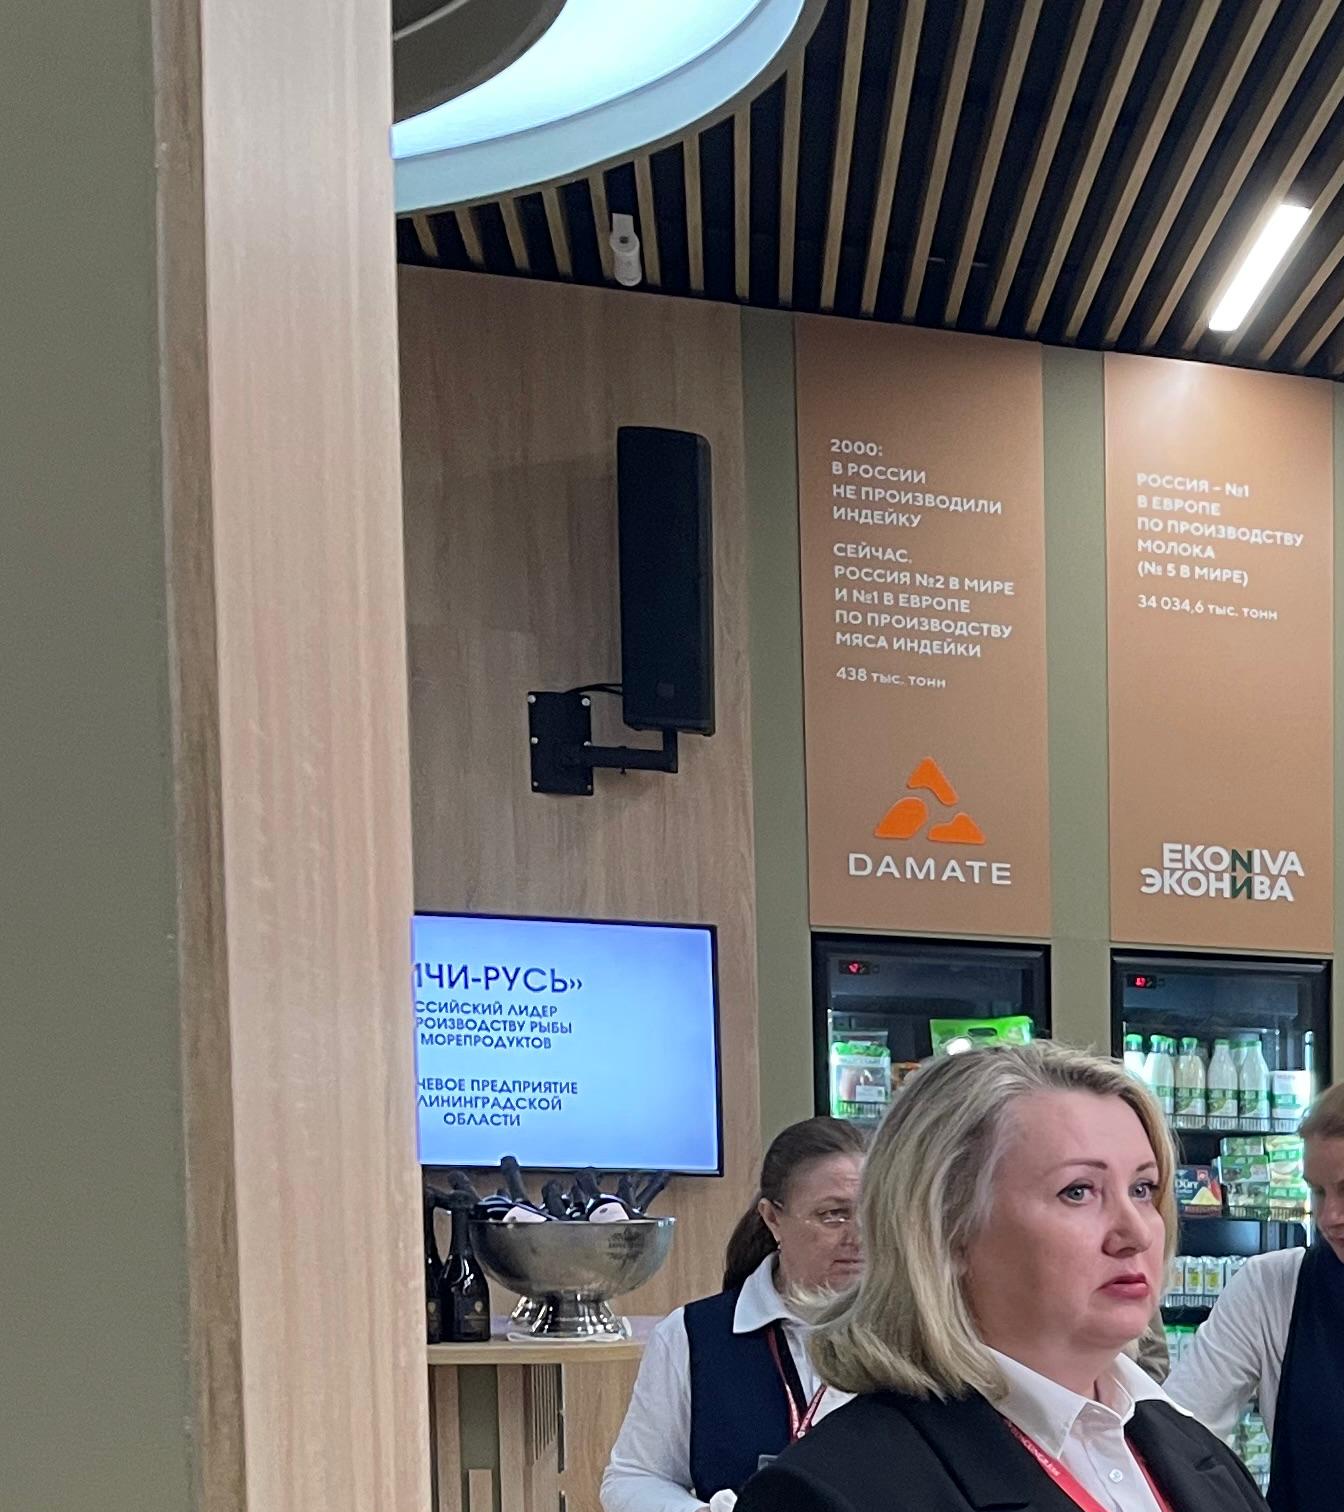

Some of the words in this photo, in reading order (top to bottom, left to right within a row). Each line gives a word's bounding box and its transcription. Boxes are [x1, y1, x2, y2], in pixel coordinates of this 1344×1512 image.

[830, 438, 883, 457] 2000:
[831, 461, 843, 475] В
[847, 463, 927, 484] РОССИИ
[1136, 472, 1209, 493] РОССИЯ
[1225, 482, 1249, 497] №1
[832, 484, 857, 499] НЕ
[861, 486, 1003, 515] ПРОИЗВОДИЛИ
[1137, 494, 1148, 509] В
[1152, 496, 1221, 516] ЕВРОПЕ
[833, 505, 921, 528] ИНДЕЙКУ
[1137, 516, 1163, 531] ПО
[1167, 519, 1304, 547] ПРОИЗВОДСТВУ
[1137, 538, 1216, 560] МОЛОКА
[834, 565, 911, 586] РОССИЯ
[915, 573, 945, 589] №2
[949, 576, 961, 590] В
[964, 578, 1015, 595] МИРЕ
[1166, 563, 1176, 577] 5
[1180, 564, 1191, 578] В
[1194, 566, 1249, 588] МИРЕ)
[834, 587, 848, 602] И
[852, 590, 879, 604] №1
[883, 592, 894, 606] В
[898, 593, 971, 613] ЕВРОПЕ
[1137, 594, 1157, 608] 34
[1160, 596, 1205, 614] 034,6
[1241, 607, 1278, 620] тонн
[835, 609, 863, 625] ПО
[866, 612, 1013, 639] ПРОИЗВОДСТВУ
[835, 631, 888, 650] МЯСА
[892, 637, 982, 658] ИНДЕЙКИ
[836, 666, 868, 682] 438
[908, 675, 946, 688] тонн
[848, 852, 1013, 886] DAMATE
[1162, 842, 1305, 877] EKONIVA
[1140, 866, 1296, 902] ЭКОНИВА
[507, 1004, 558, 1019] ЛИДЕР
[530, 1020, 573, 1034] РЫБЫ
[420, 1032, 552, 1050] МОРЕПРОДУКТОВ
[470, 1079, 579, 1095] ПРЕДПРИЯТИЕ
[418, 1094, 562, 1112] ЛИНИНГРАДСКОЙ
[443, 1112, 521, 1127] ОБЛАСТИ
